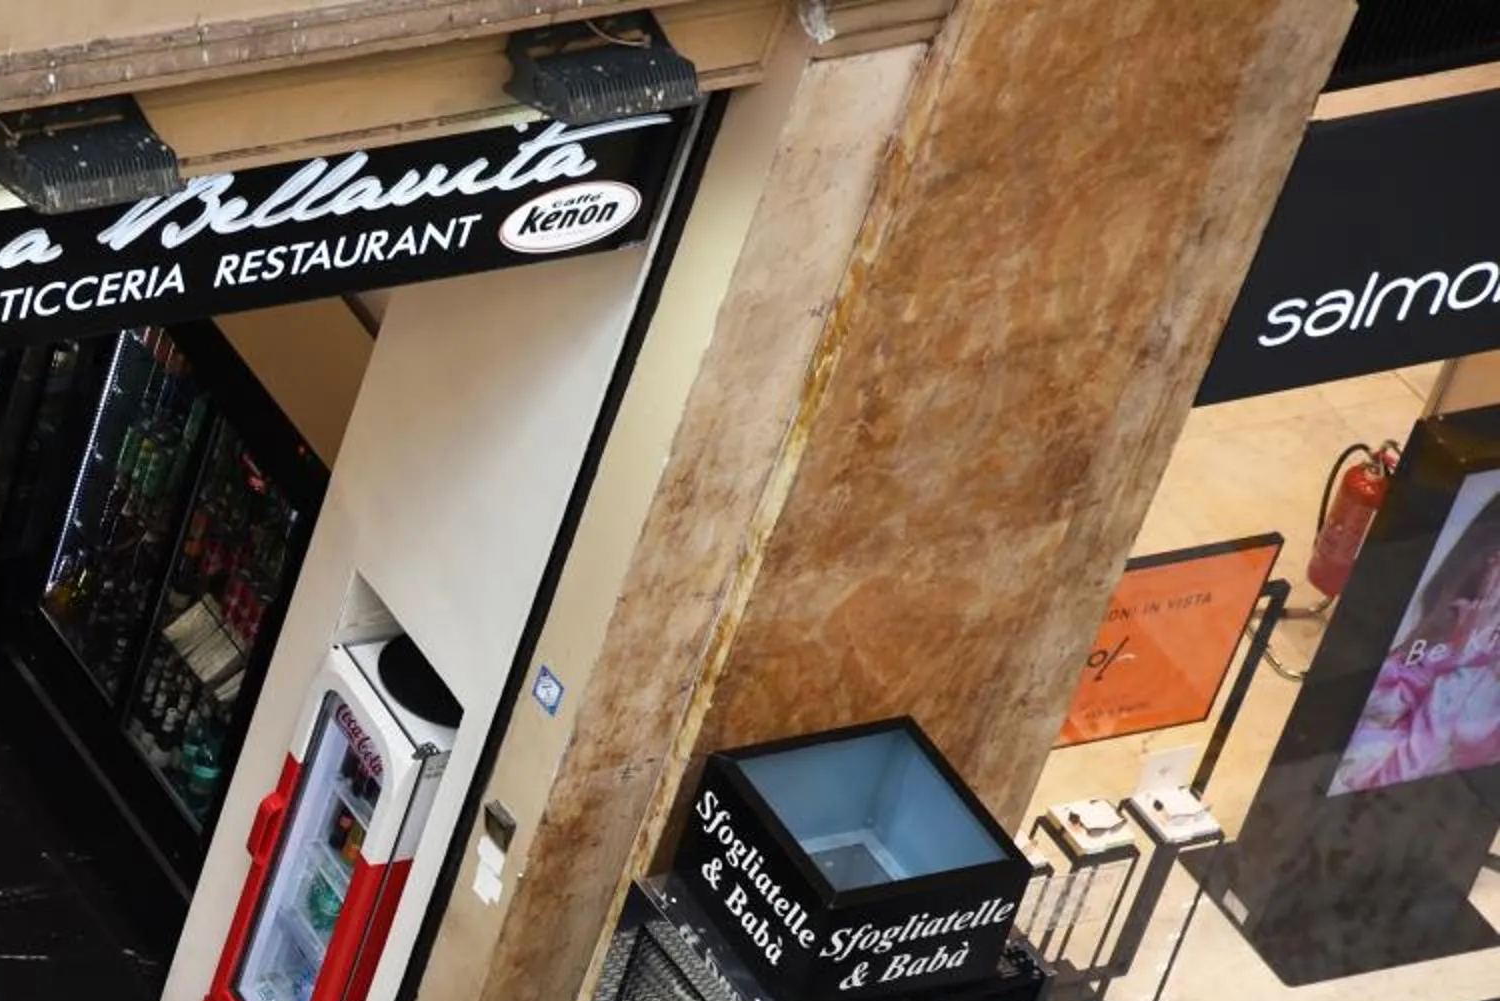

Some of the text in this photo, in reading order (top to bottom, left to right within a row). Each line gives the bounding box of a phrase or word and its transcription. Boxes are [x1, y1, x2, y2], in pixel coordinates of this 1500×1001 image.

[97, 113, 674, 251] Bellavita
[214, 214, 483, 288] RESTAURANT
[1257, 261, 1500, 347] salmo
[696, 790, 815, 949] Sfogliatelle
[701, 857, 784, 966] & Babà
[820, 897, 1015, 961] Sfogliatelle
[839, 940, 970, 991] & Babà
